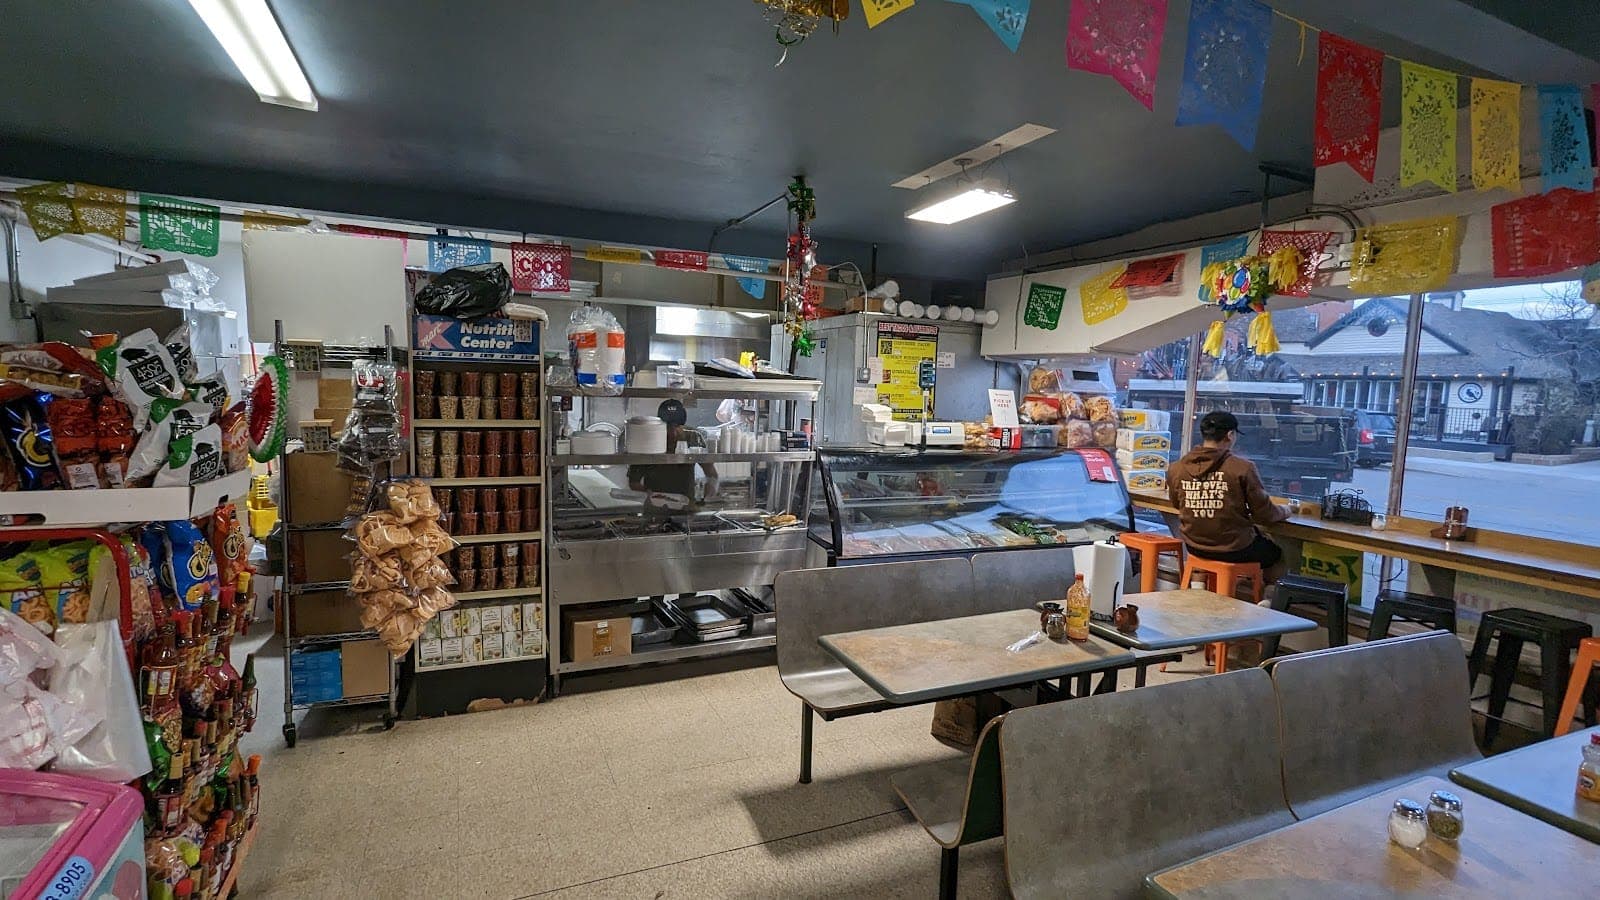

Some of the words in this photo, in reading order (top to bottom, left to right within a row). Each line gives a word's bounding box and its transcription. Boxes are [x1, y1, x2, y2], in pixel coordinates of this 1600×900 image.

[460, 322, 514, 336] Nutriti
[460, 335, 513, 350] Center
[1181, 480, 1202, 490] TRIP
[1203, 480, 1229, 491] OVER
[1185, 489, 1225, 500] WHAT'S
[1185, 499, 1224, 509] BEHIND
[1192, 509, 1216, 518] YOU
